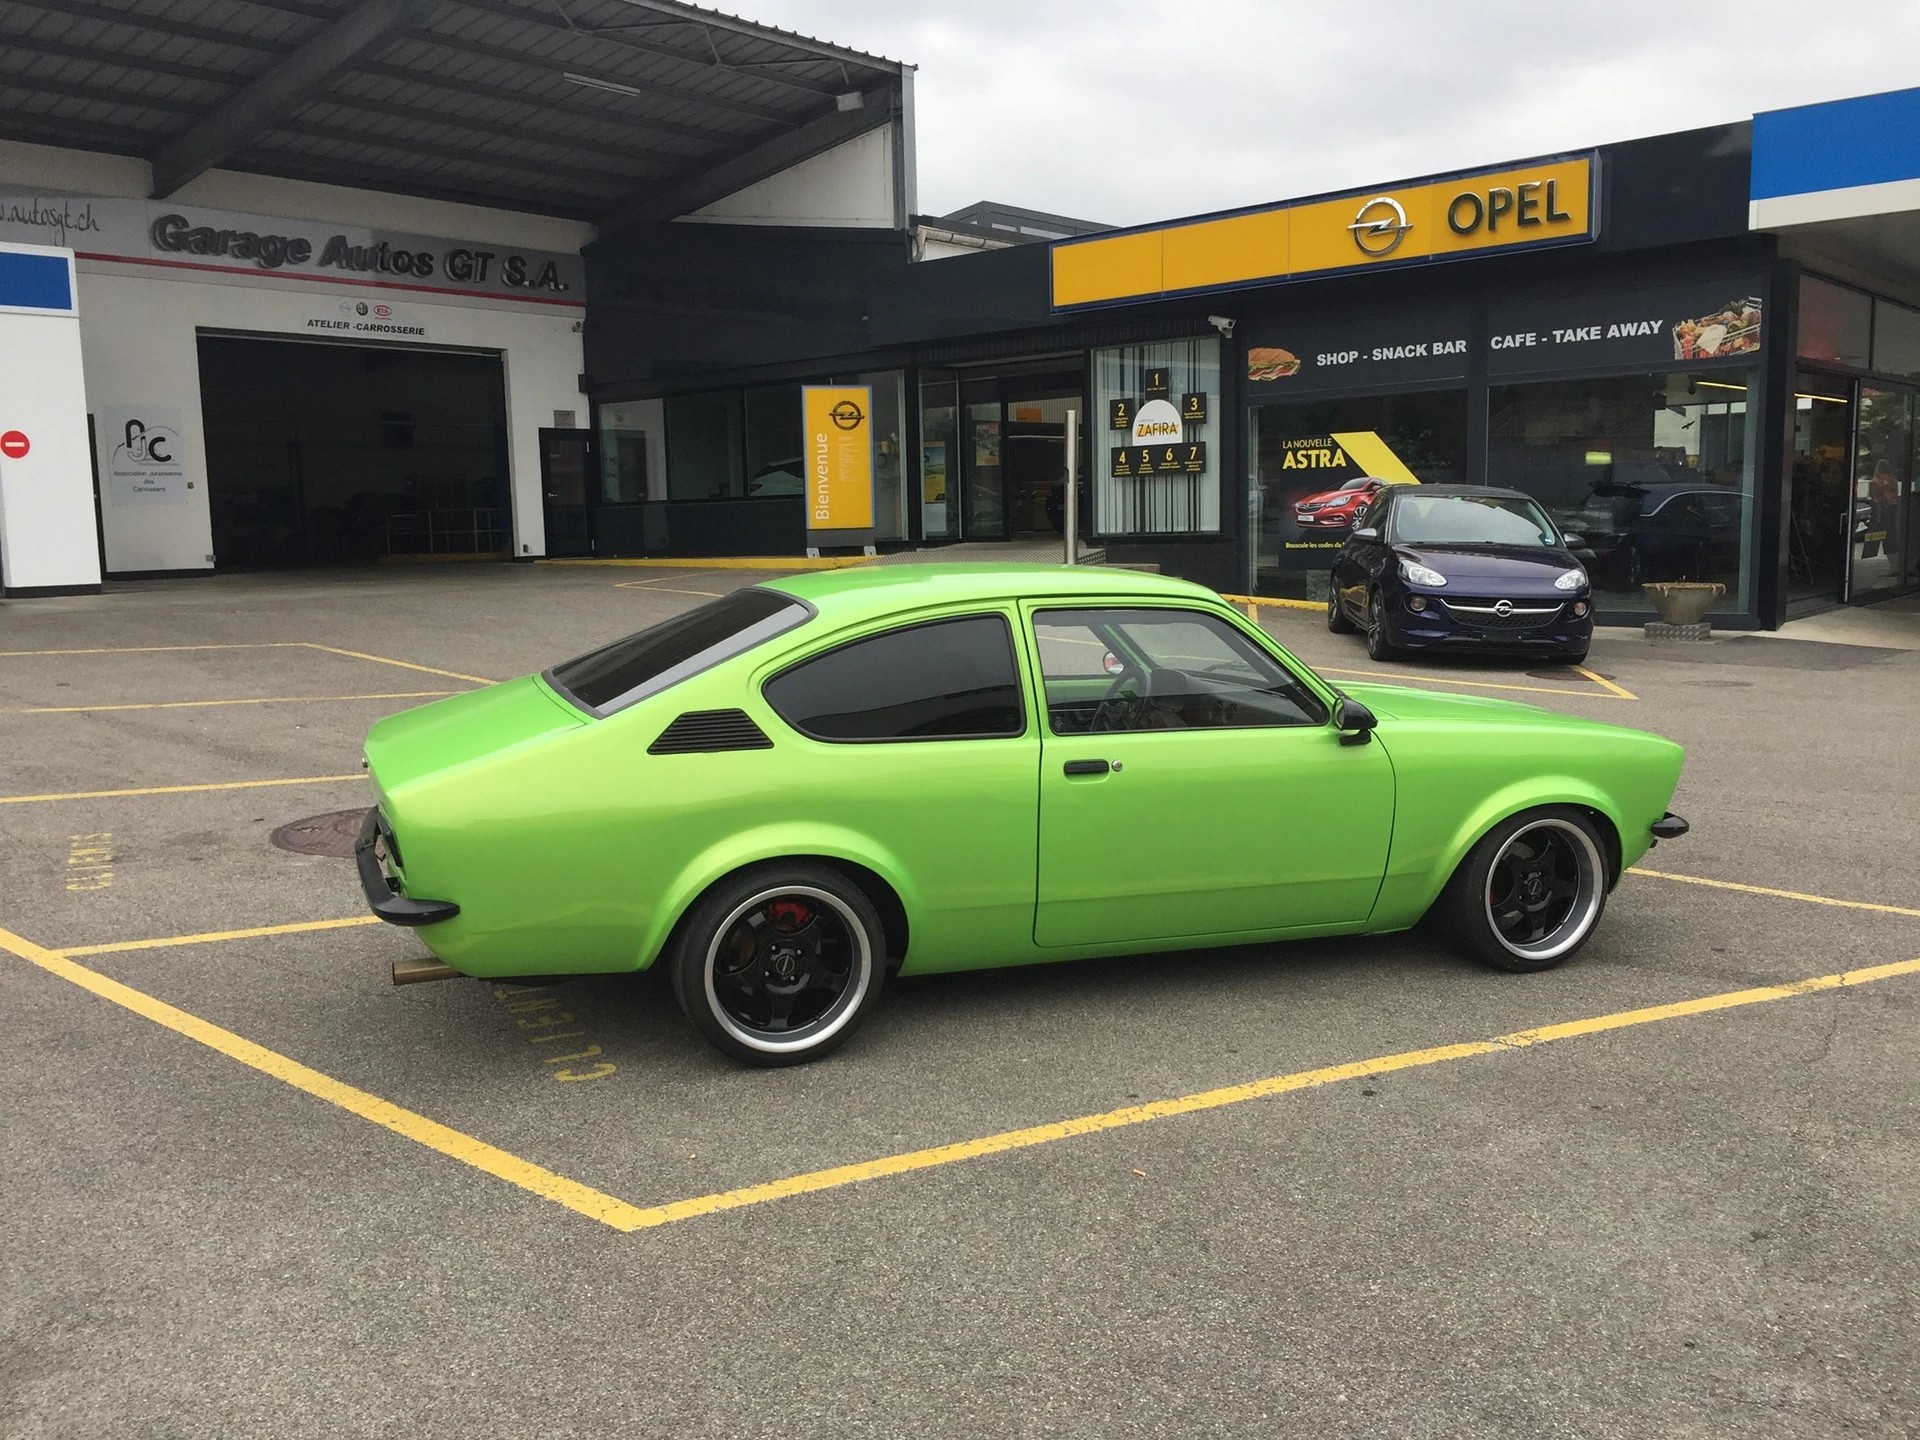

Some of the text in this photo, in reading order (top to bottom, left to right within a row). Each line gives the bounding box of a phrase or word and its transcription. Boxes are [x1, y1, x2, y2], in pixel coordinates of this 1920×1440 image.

[1447, 178, 1571, 236] OPEL
[151, 213, 569, 291] Garage Autos GT S.A.
[306, 319, 350, 330] ATELIER
[1490, 332, 1537, 350] CAFE
[1552, 326, 1602, 343] TAKE
[1606, 320, 1664, 338] AWAY
[1316, 351, 1359, 366] SHOP
[1372, 343, 1428, 361] SNACK
[1432, 339, 1467, 355] BAR
[1154, 372, 1160, 386] 1
[1118, 403, 1125, 416] 2
[1190, 397, 1198, 411] 3
[1137, 422, 1178, 438] ZAFIRA
[1282, 437, 1333, 449] LA NOUVELLE
[1119, 446, 1197, 464] 4 5 6 7
[1282, 448, 1347, 470] ASTRA
[816, 433, 830, 520] Bienvenue
